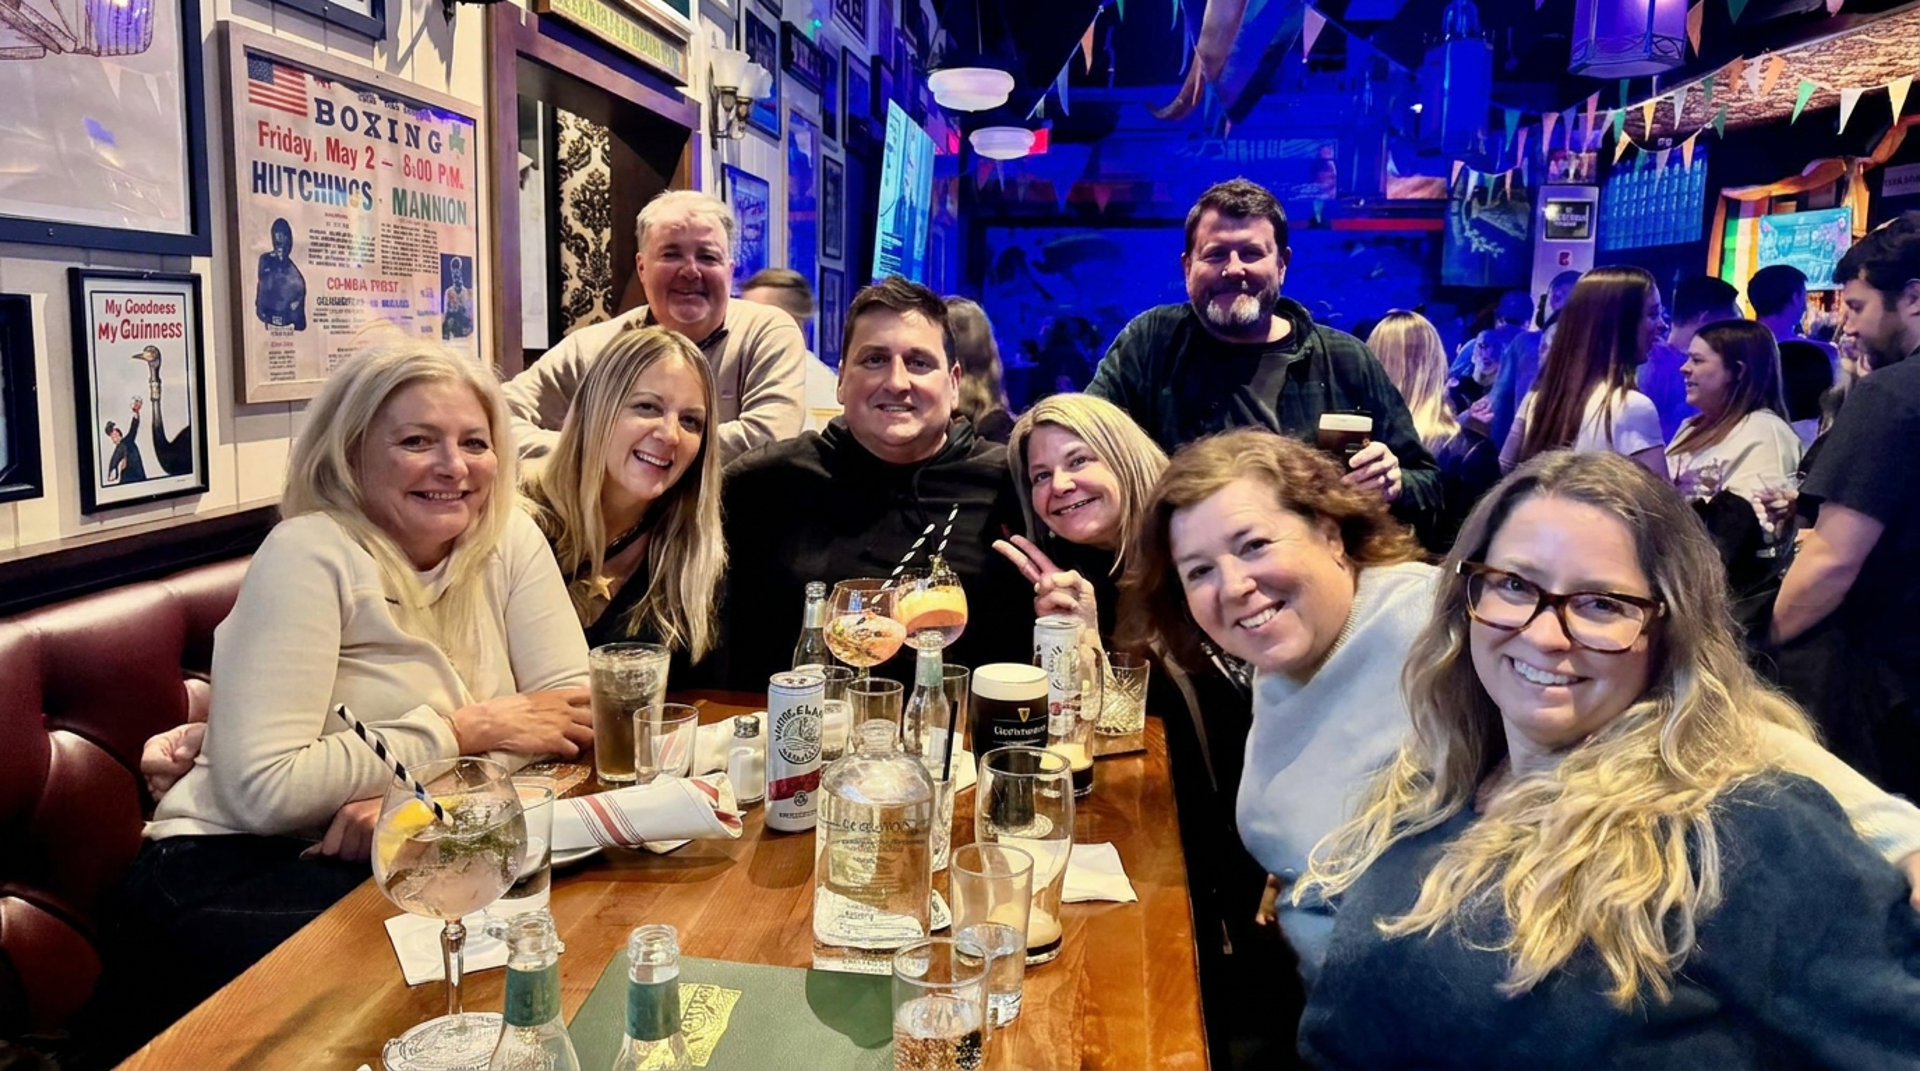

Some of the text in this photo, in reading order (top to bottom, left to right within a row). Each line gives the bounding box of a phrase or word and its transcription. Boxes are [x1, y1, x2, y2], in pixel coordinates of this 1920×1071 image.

[257, 119, 318, 163] Friday,
[325, 136, 358, 171] May
[364, 145, 376, 170] 2
[314, 97, 442, 154] BOXING
[252, 160, 467, 225] HUTCHINGS MANNION
[98, 318, 182, 343] My Guinness
[105, 299, 122, 317] My
